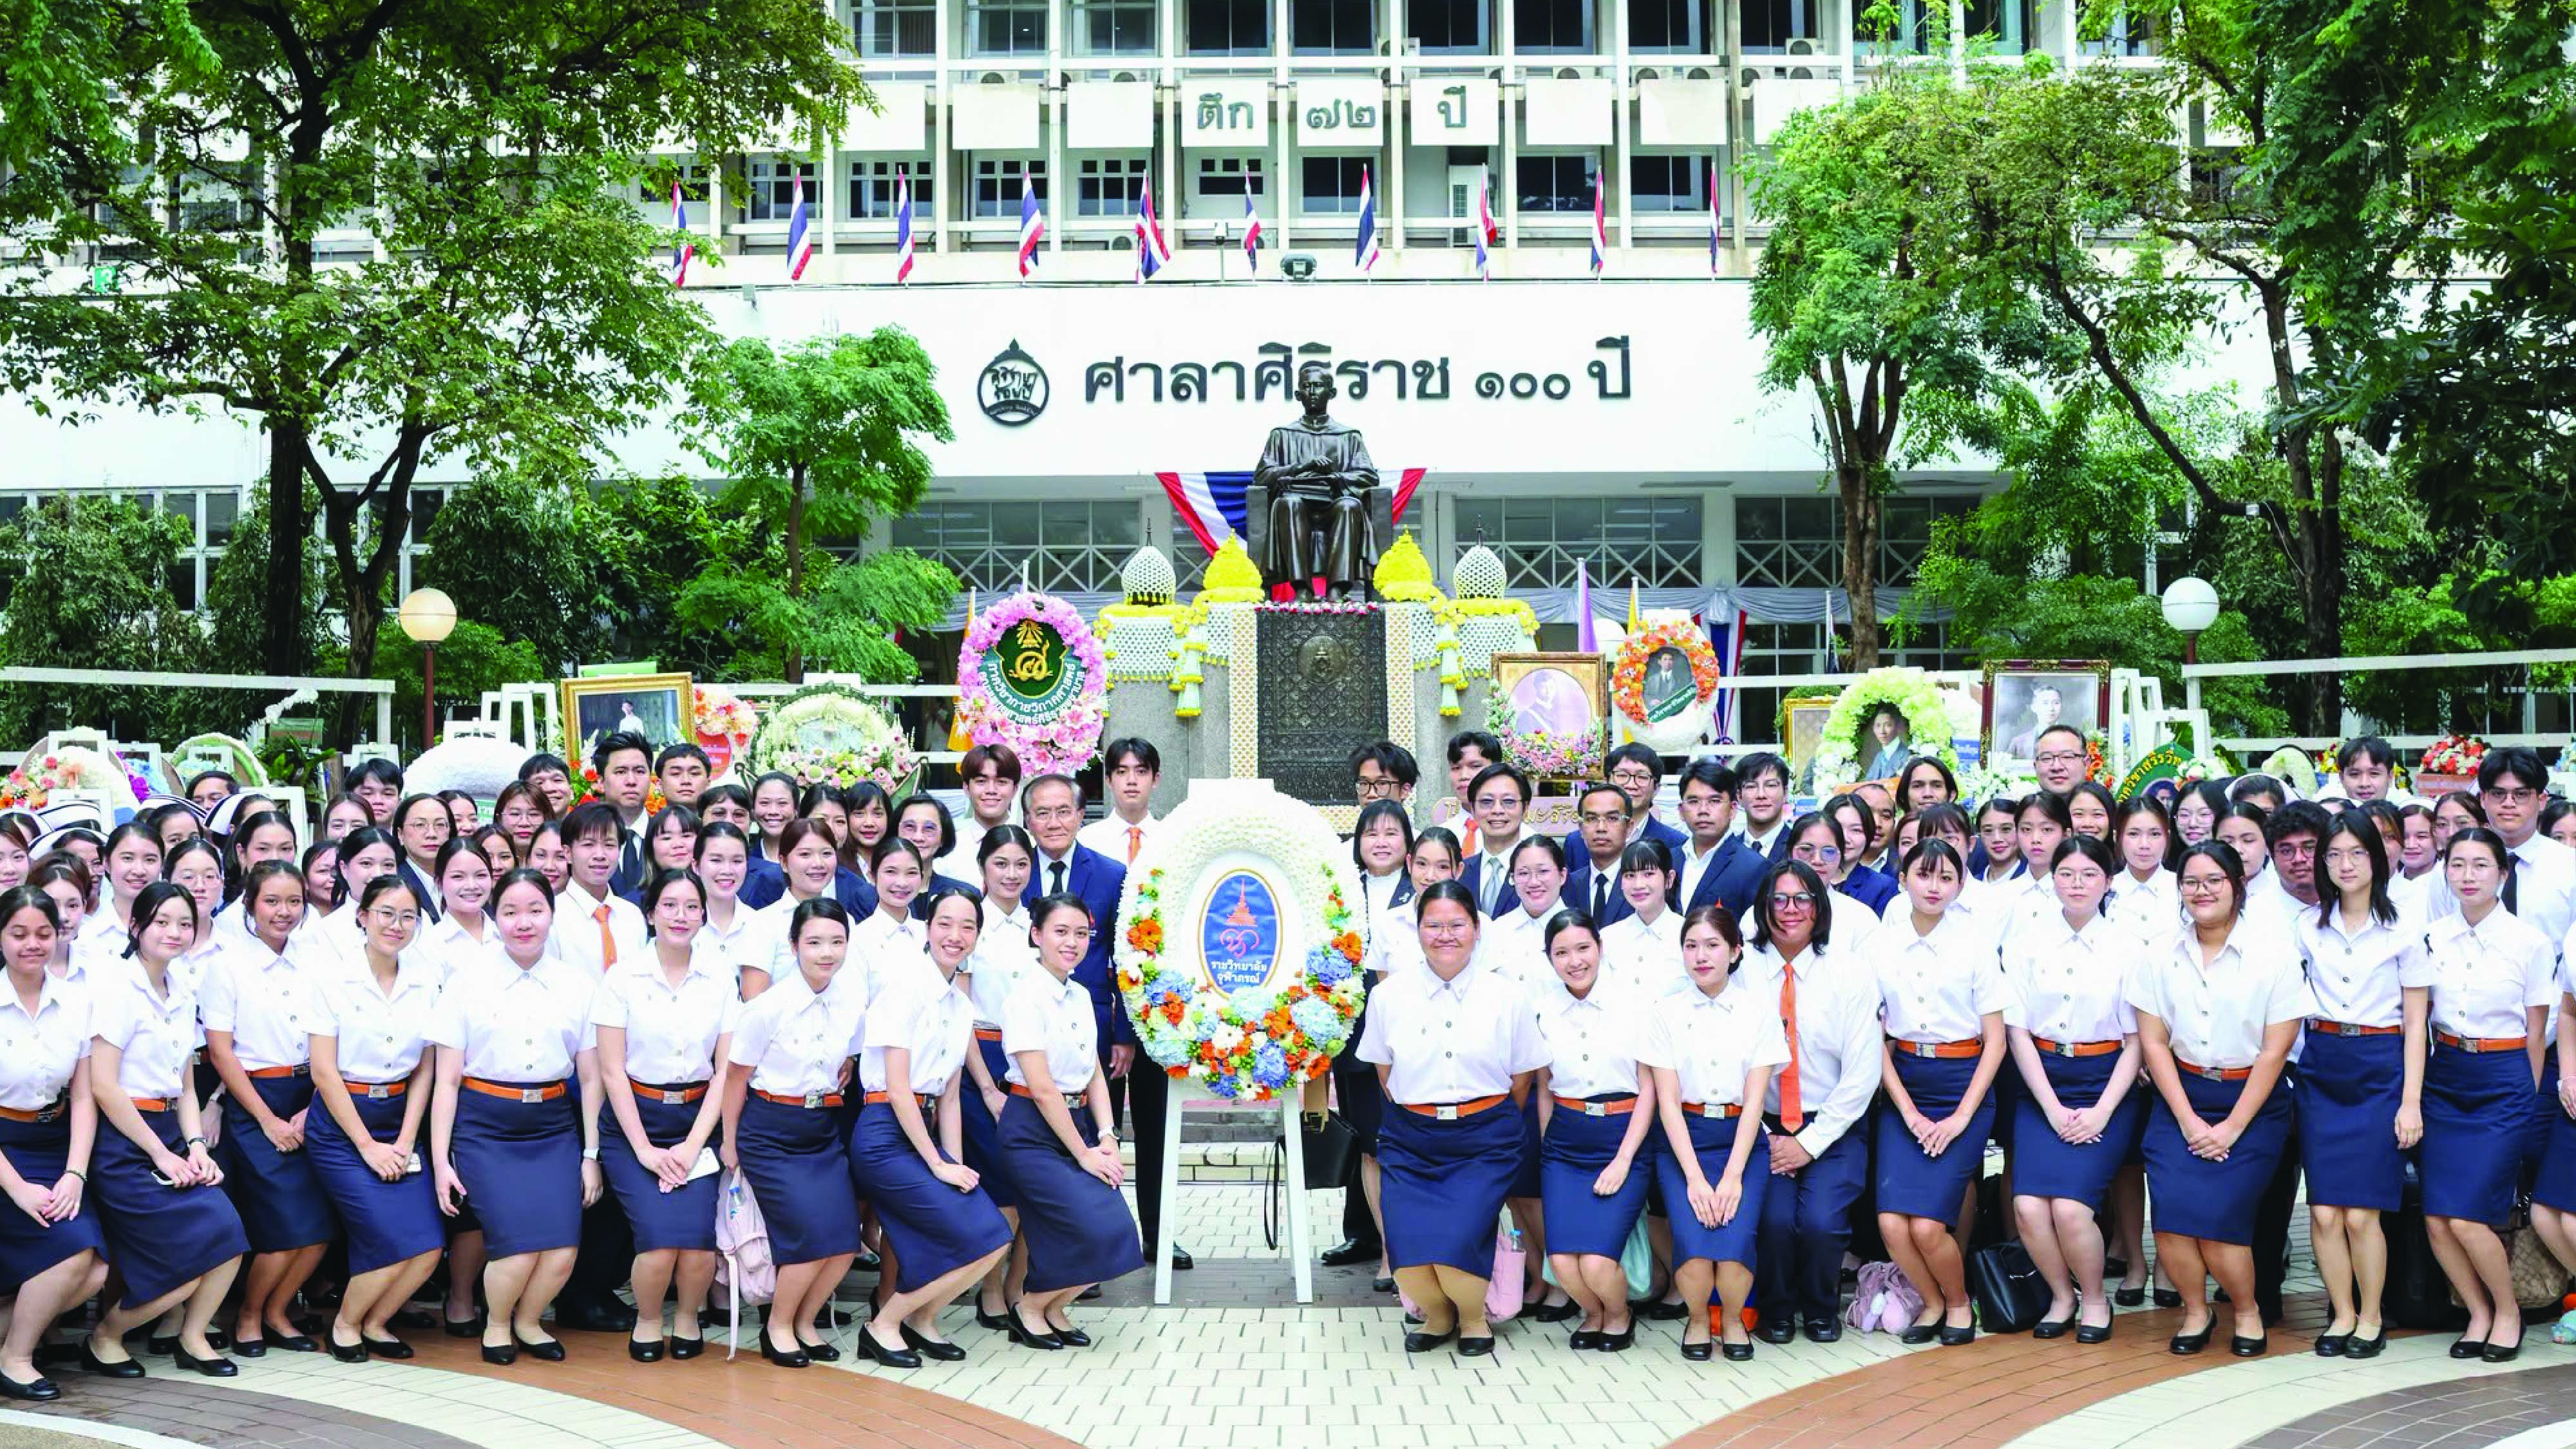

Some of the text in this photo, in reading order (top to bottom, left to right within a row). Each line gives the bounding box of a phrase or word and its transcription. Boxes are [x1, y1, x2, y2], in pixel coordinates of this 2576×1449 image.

[1197, 85, 1466, 129] ตึก ๗๒ ปี
[1085, 336, 1631, 402] ศาลาศิิราช ๑๐๐ ปี
